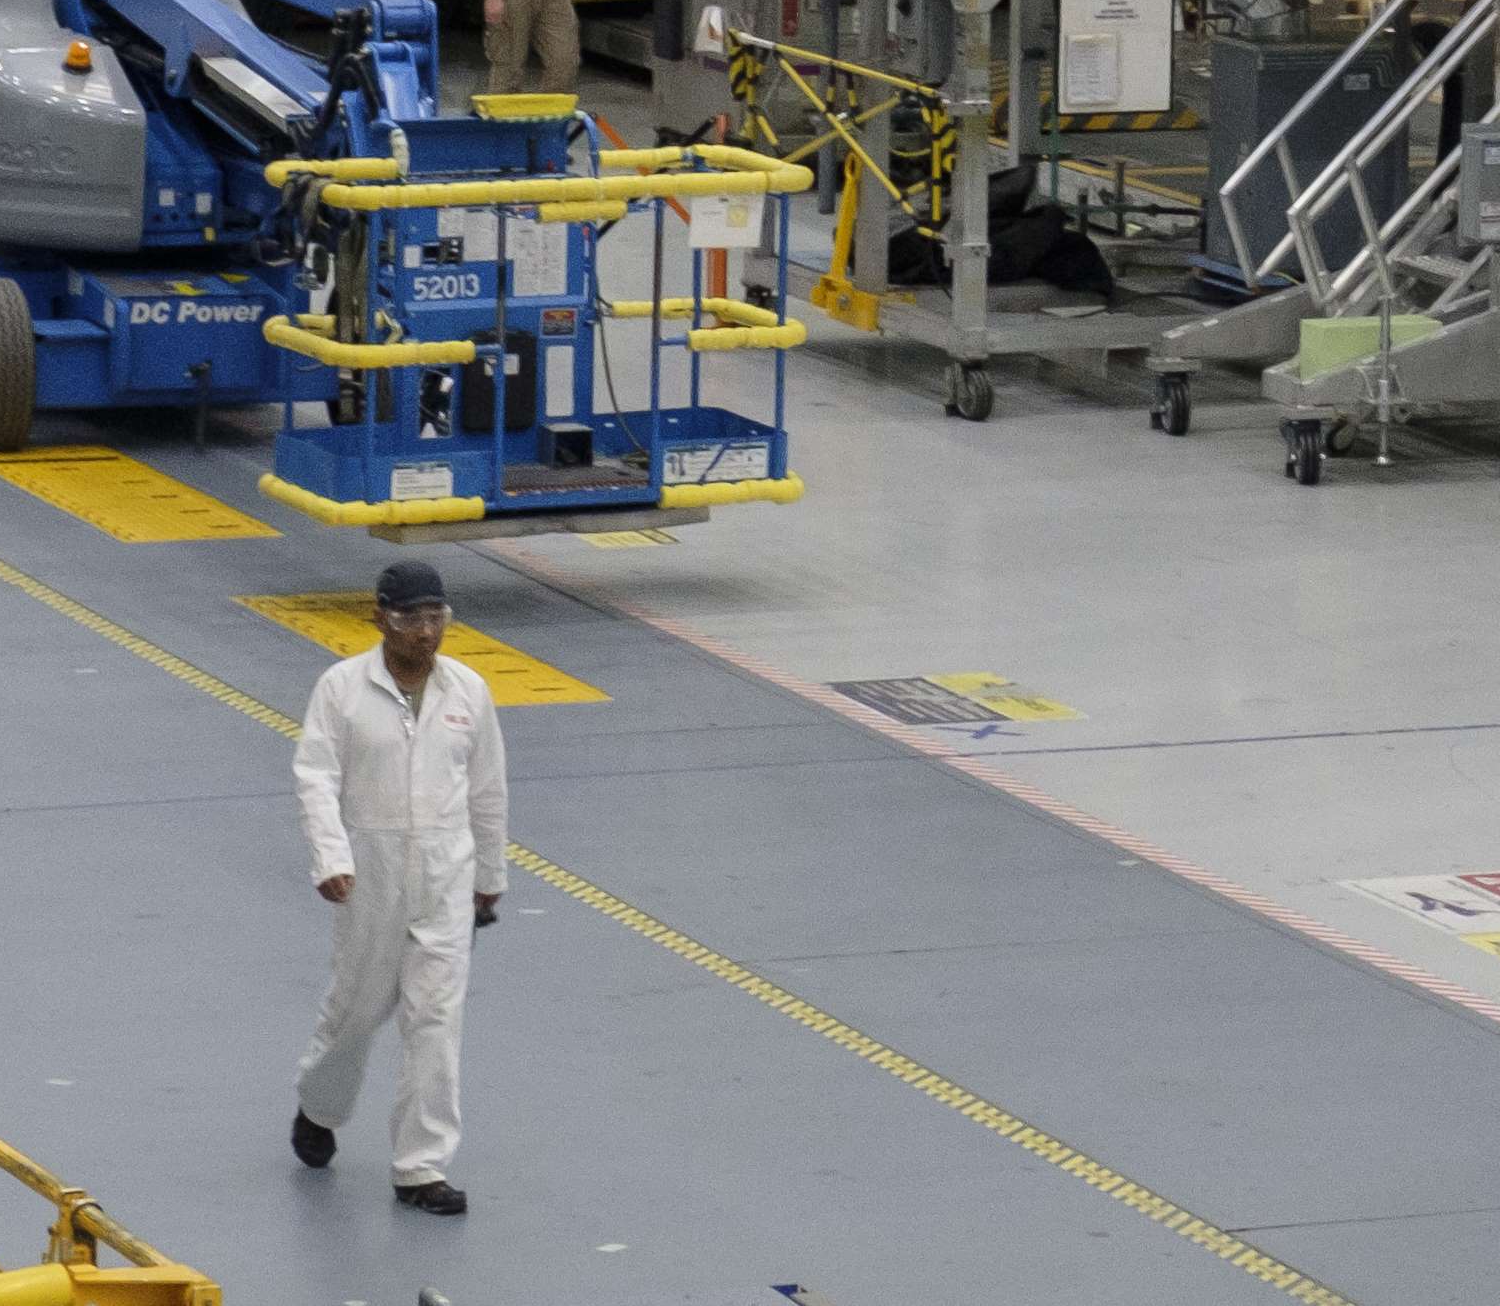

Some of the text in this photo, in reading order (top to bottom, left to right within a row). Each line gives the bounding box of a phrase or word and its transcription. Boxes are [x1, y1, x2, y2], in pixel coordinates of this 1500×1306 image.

[413, 274, 480, 301] 52013
[130, 301, 264, 324] DC Power
